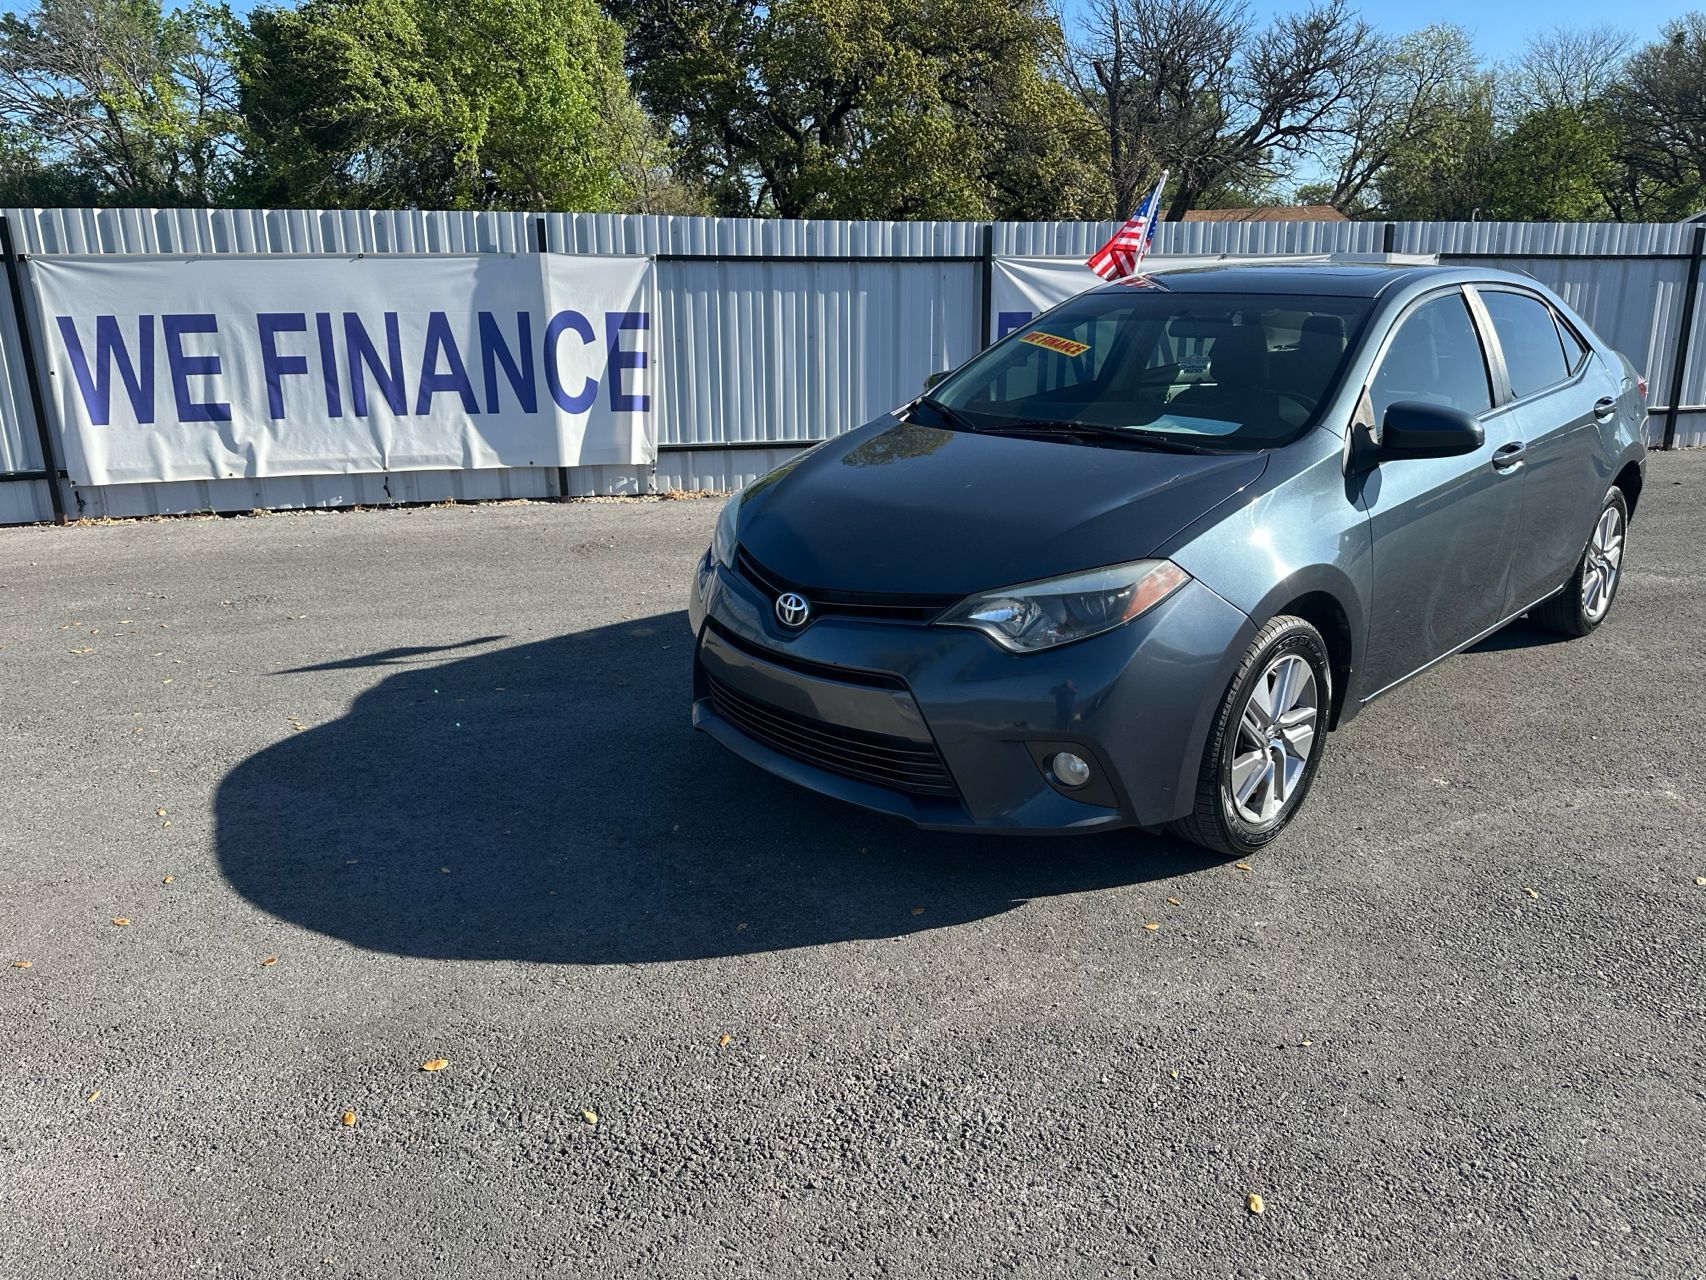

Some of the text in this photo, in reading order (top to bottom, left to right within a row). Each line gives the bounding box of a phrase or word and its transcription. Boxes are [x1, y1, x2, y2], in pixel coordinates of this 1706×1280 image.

[56, 309, 650, 425] WE FINANCE
[1036, 335, 1088, 355] FINANCE
